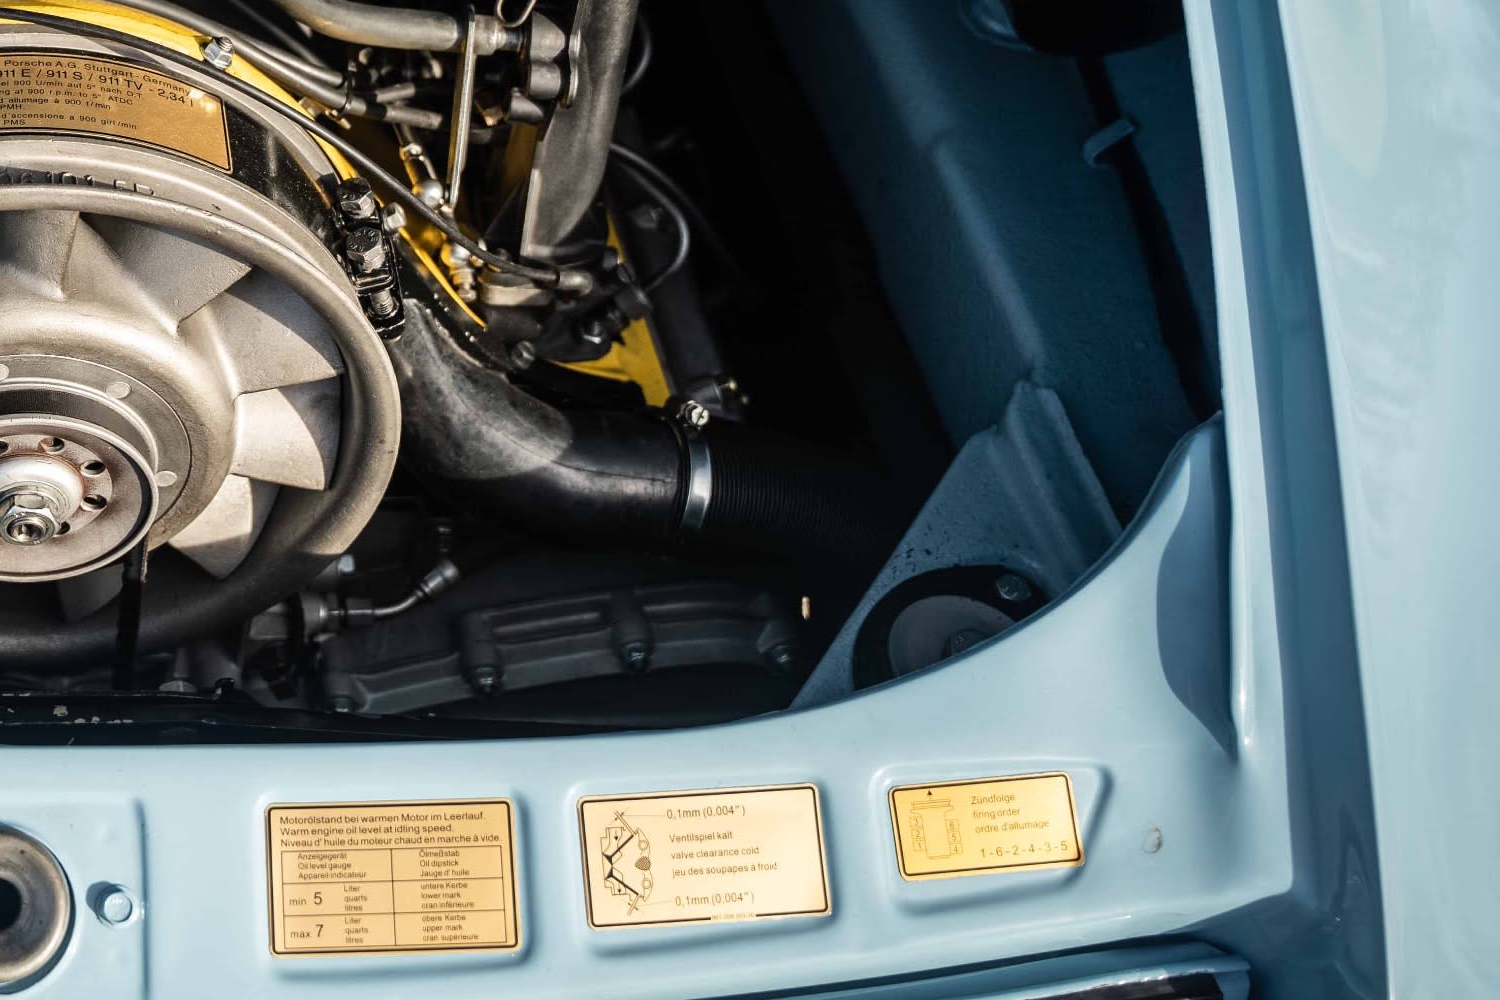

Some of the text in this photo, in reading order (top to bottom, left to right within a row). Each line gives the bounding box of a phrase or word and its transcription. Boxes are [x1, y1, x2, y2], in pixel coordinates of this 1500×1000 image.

[84, 64, 133, 77] Stuttgart
[21, 69, 31, 77] E
[47, 70, 67, 78] 911
[73, 72, 83, 80] S
[99, 75, 119, 85] 911
[124, 79, 142, 90] TV
[344, 815, 359, 823] bei
[400, 813, 428, 821] Motor
[280, 827, 309, 836] Warm
[311, 826, 344, 837] engine
[345, 826, 357, 834] oil
[358, 825, 381, 834] level
[394, 824, 420, 834] idling
[280, 838, 313, 847] Niveau
[323, 838, 346, 846] huile
[347, 837, 358, 845] du
[360, 837, 392, 845] moteur
[393, 836, 422, 844] chaud
[436, 834, 472, 843] marche
[313, 891, 323, 905] 5
[315, 924, 324, 937] 7
